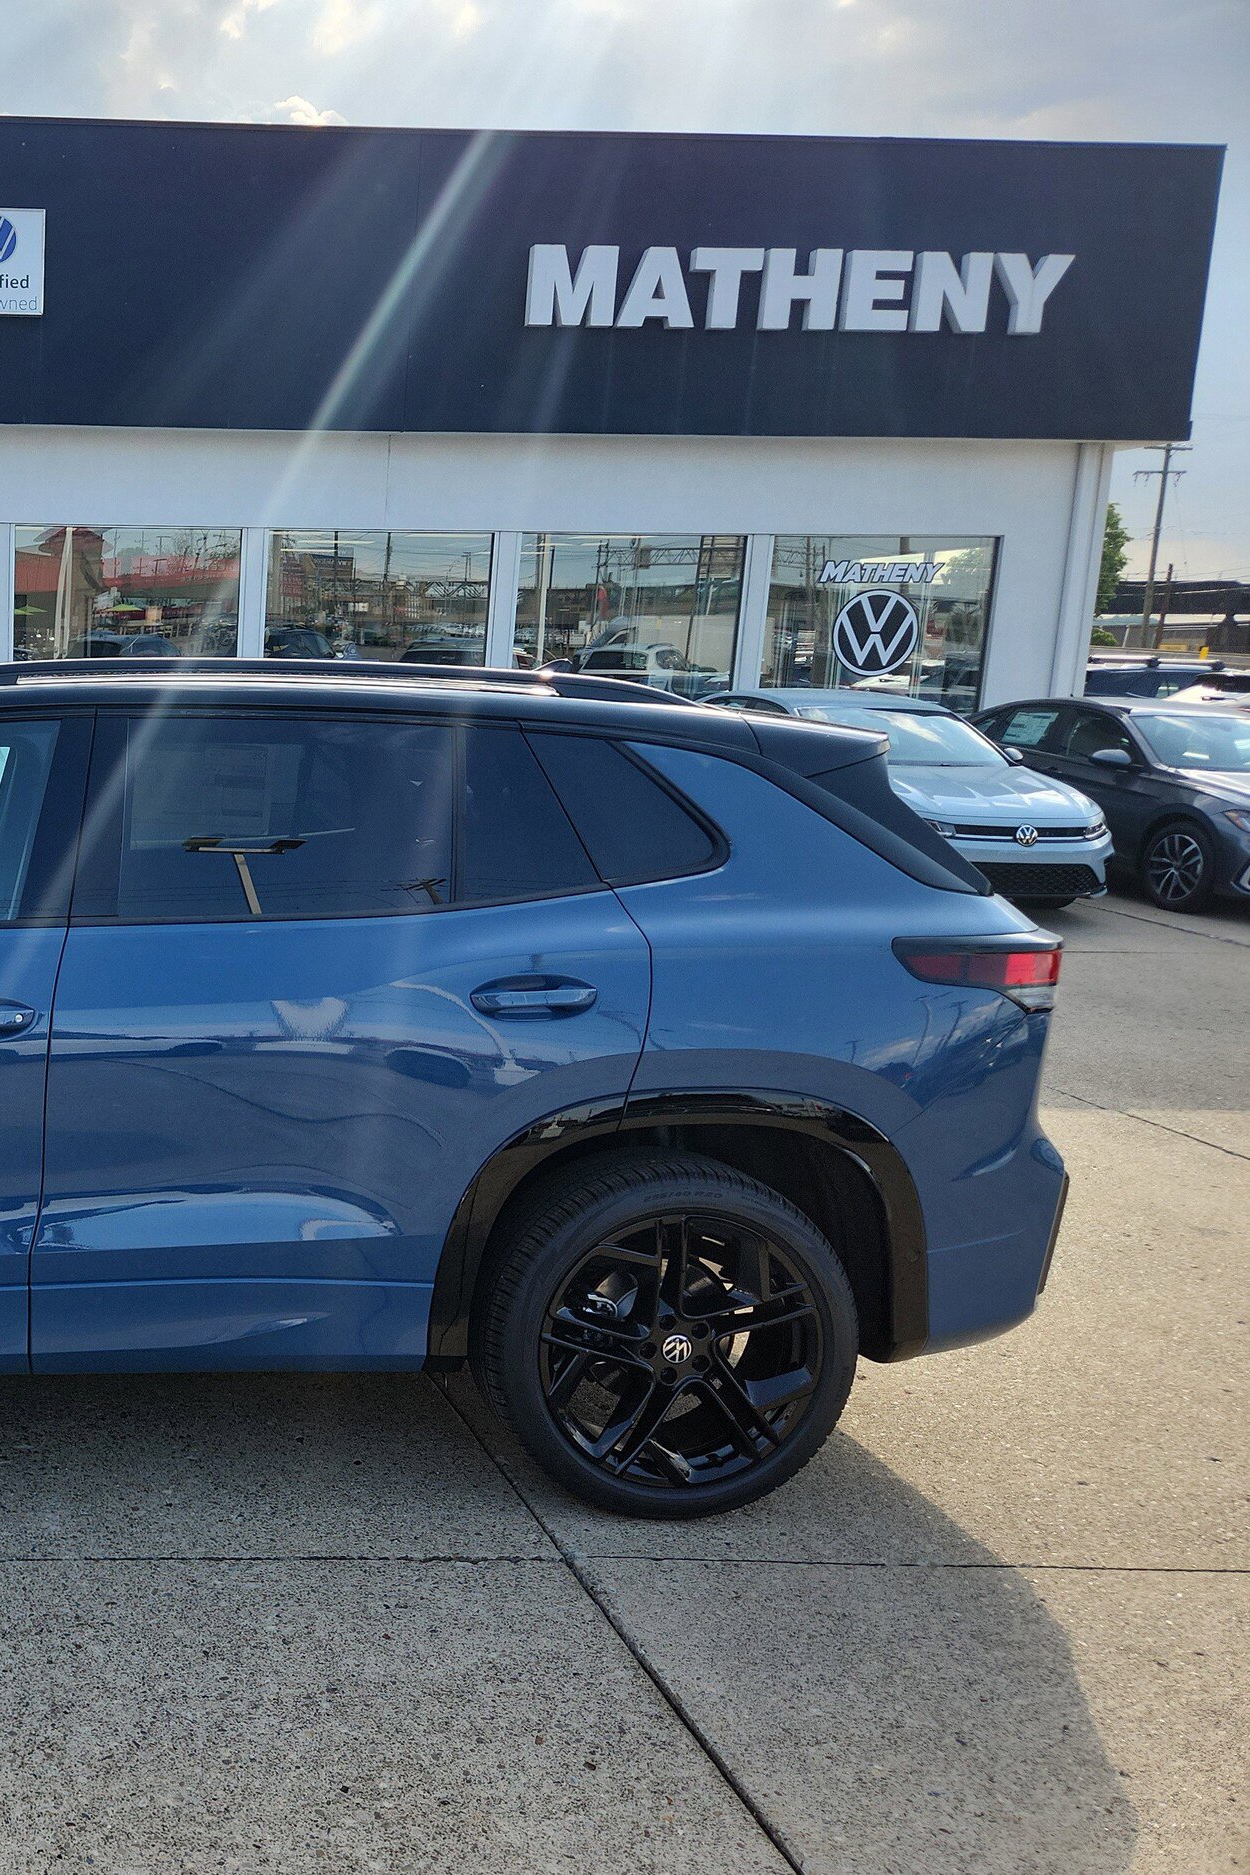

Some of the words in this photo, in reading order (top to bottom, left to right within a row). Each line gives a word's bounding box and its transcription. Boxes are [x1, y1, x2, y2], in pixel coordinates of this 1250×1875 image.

[524, 244, 1076, 335] MATHENY
[819, 561, 945, 583] MATHENY
[833, 590, 918, 675] VW
